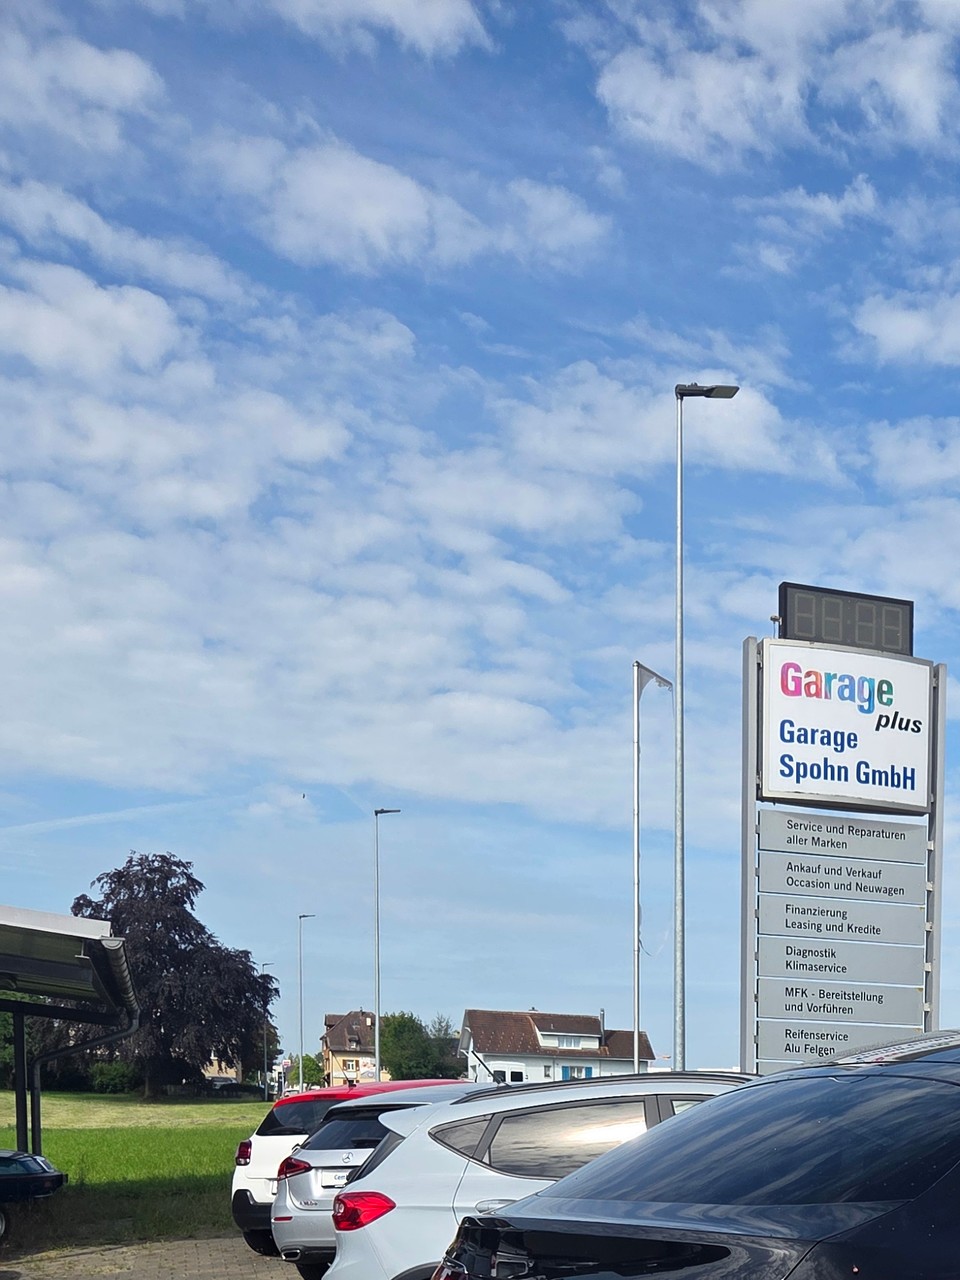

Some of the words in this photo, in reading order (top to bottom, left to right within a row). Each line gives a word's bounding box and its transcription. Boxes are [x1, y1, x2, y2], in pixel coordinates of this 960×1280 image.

[780, 662, 893, 714] Garage
[875, 712, 922, 733] plus
[780, 719, 858, 752] Garage
[780, 754, 848, 784] Spohn
[856, 761, 915, 790] GmbH
[787, 820, 822, 832] Service
[826, 825, 844, 834] und
[848, 826, 905, 840] Reparaturen
[787, 835, 808, 846] aller
[811, 837, 847, 849] Marken
[787, 862, 821, 874] Ankauf
[824, 865, 842, 876] und
[846, 867, 881, 879] Verkauf
[787, 878, 830, 889] Occasion
[834, 881, 852, 891] und
[856, 882, 904, 896] Neuwagen
[786, 904, 847, 919] Finanzierung
[786, 919, 822, 933] Leasing
[826, 922, 844, 932] und
[848, 924, 881, 935] Kredite
[786, 946, 836, 958] Diagnostik
[786, 961, 847, 973] Klimaservice
[785, 987, 808, 998] MFK
[819, 989, 883, 1003] Bereitstellung
[785, 1002, 803, 1012] und
[807, 1003, 853, 1015] Vorführen
[785, 1029, 848, 1041] Reifenservice
[785, 1043, 800, 1054] Alu
[805, 1045, 835, 1056] Felgen
